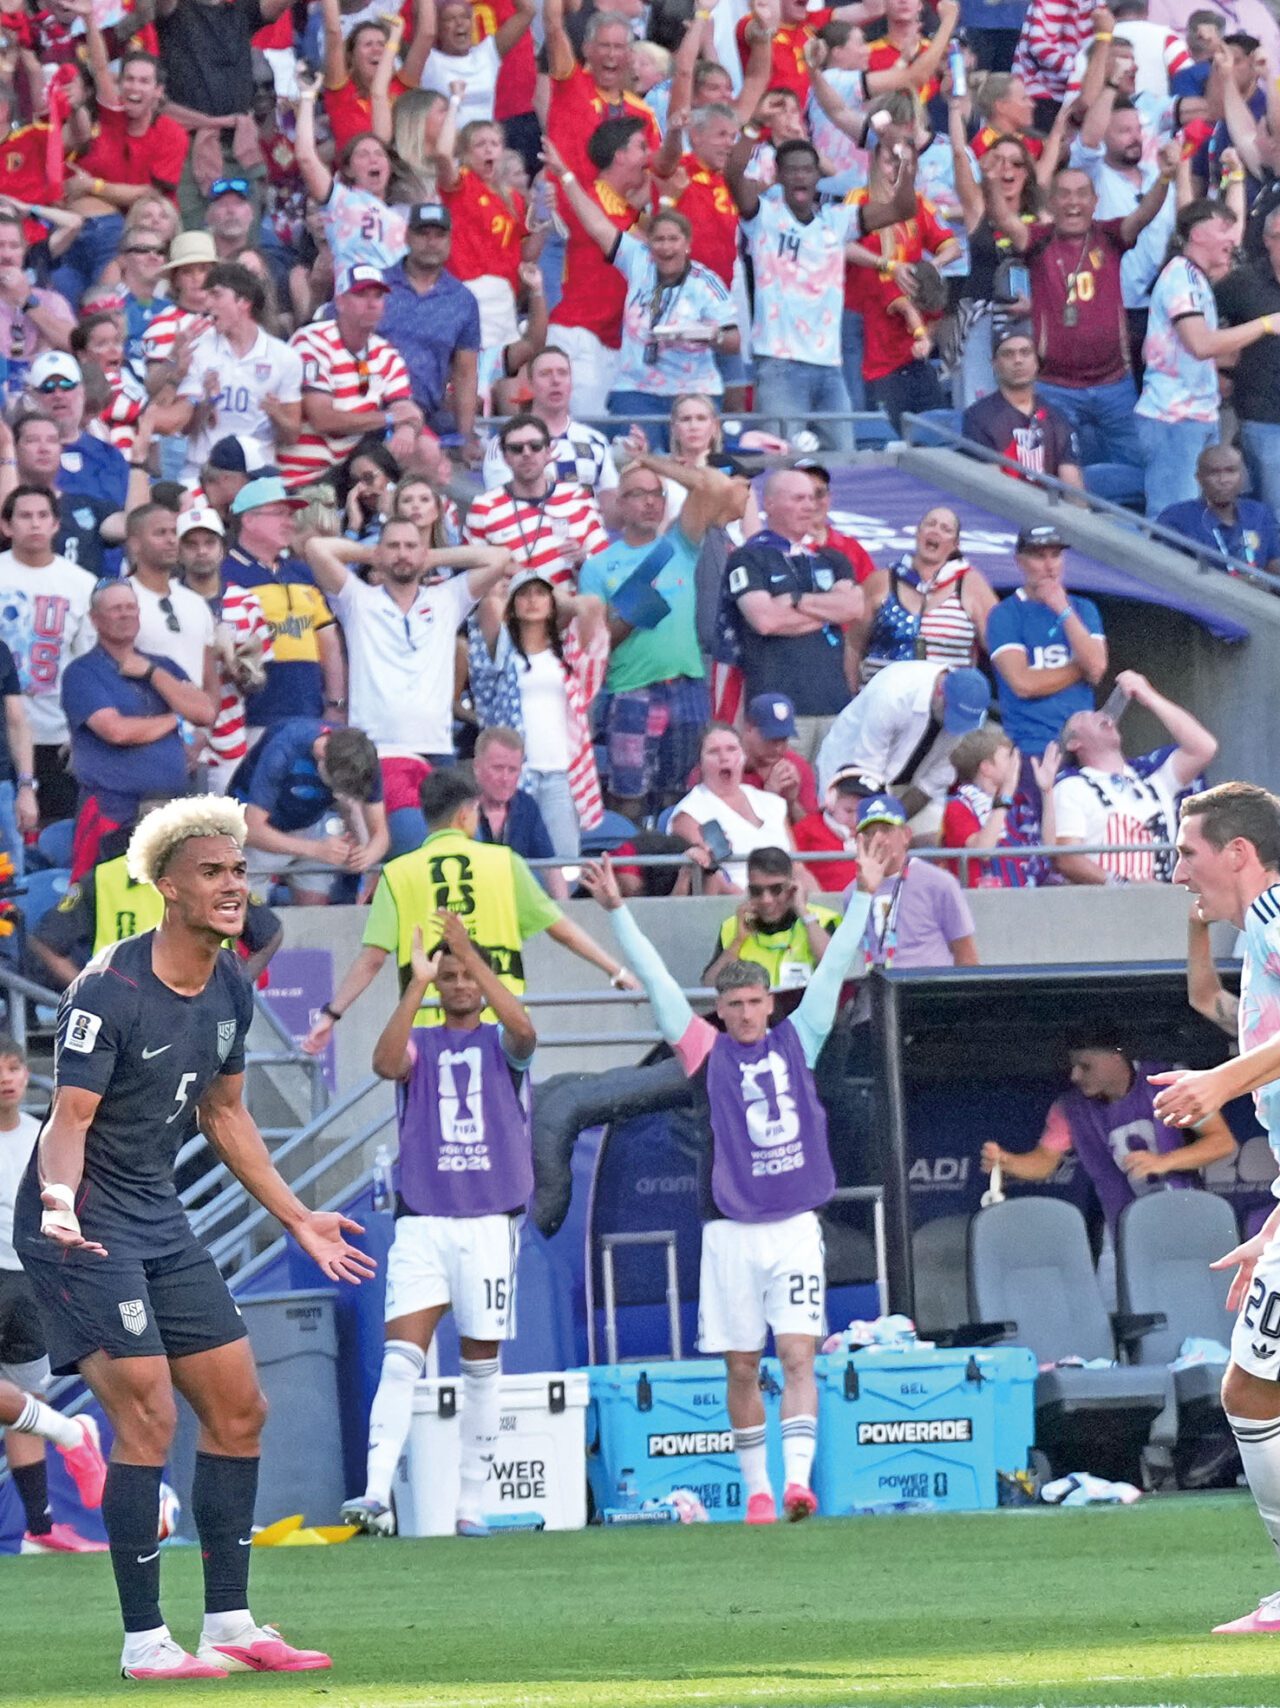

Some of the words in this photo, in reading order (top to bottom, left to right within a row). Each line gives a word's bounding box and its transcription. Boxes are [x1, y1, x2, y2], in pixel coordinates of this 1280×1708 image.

[361, 214, 384, 242] 21
[777, 231, 801, 262] 14
[221, 386, 248, 412] 10
[217, 1023, 236, 1040] USA
[165, 1072, 197, 1124] 5
[437, 1155, 491, 1171] 2026
[751, 1147, 786, 1160] WORLD
[752, 1151, 804, 1176] 2026
[483, 1278, 506, 1310] 16
[789, 1275, 820, 1305] 22
[121, 1301, 144, 1317] USA
[693, 1394, 720, 1406] BEL
[901, 1383, 928, 1395] BEL
[859, 1420, 970, 1443] POWERADE
[649, 1432, 733, 1455] POWERA
[487, 1460, 545, 1481] WER
[879, 1474, 928, 1488] POWER
[501, 1481, 546, 1500] ADE
